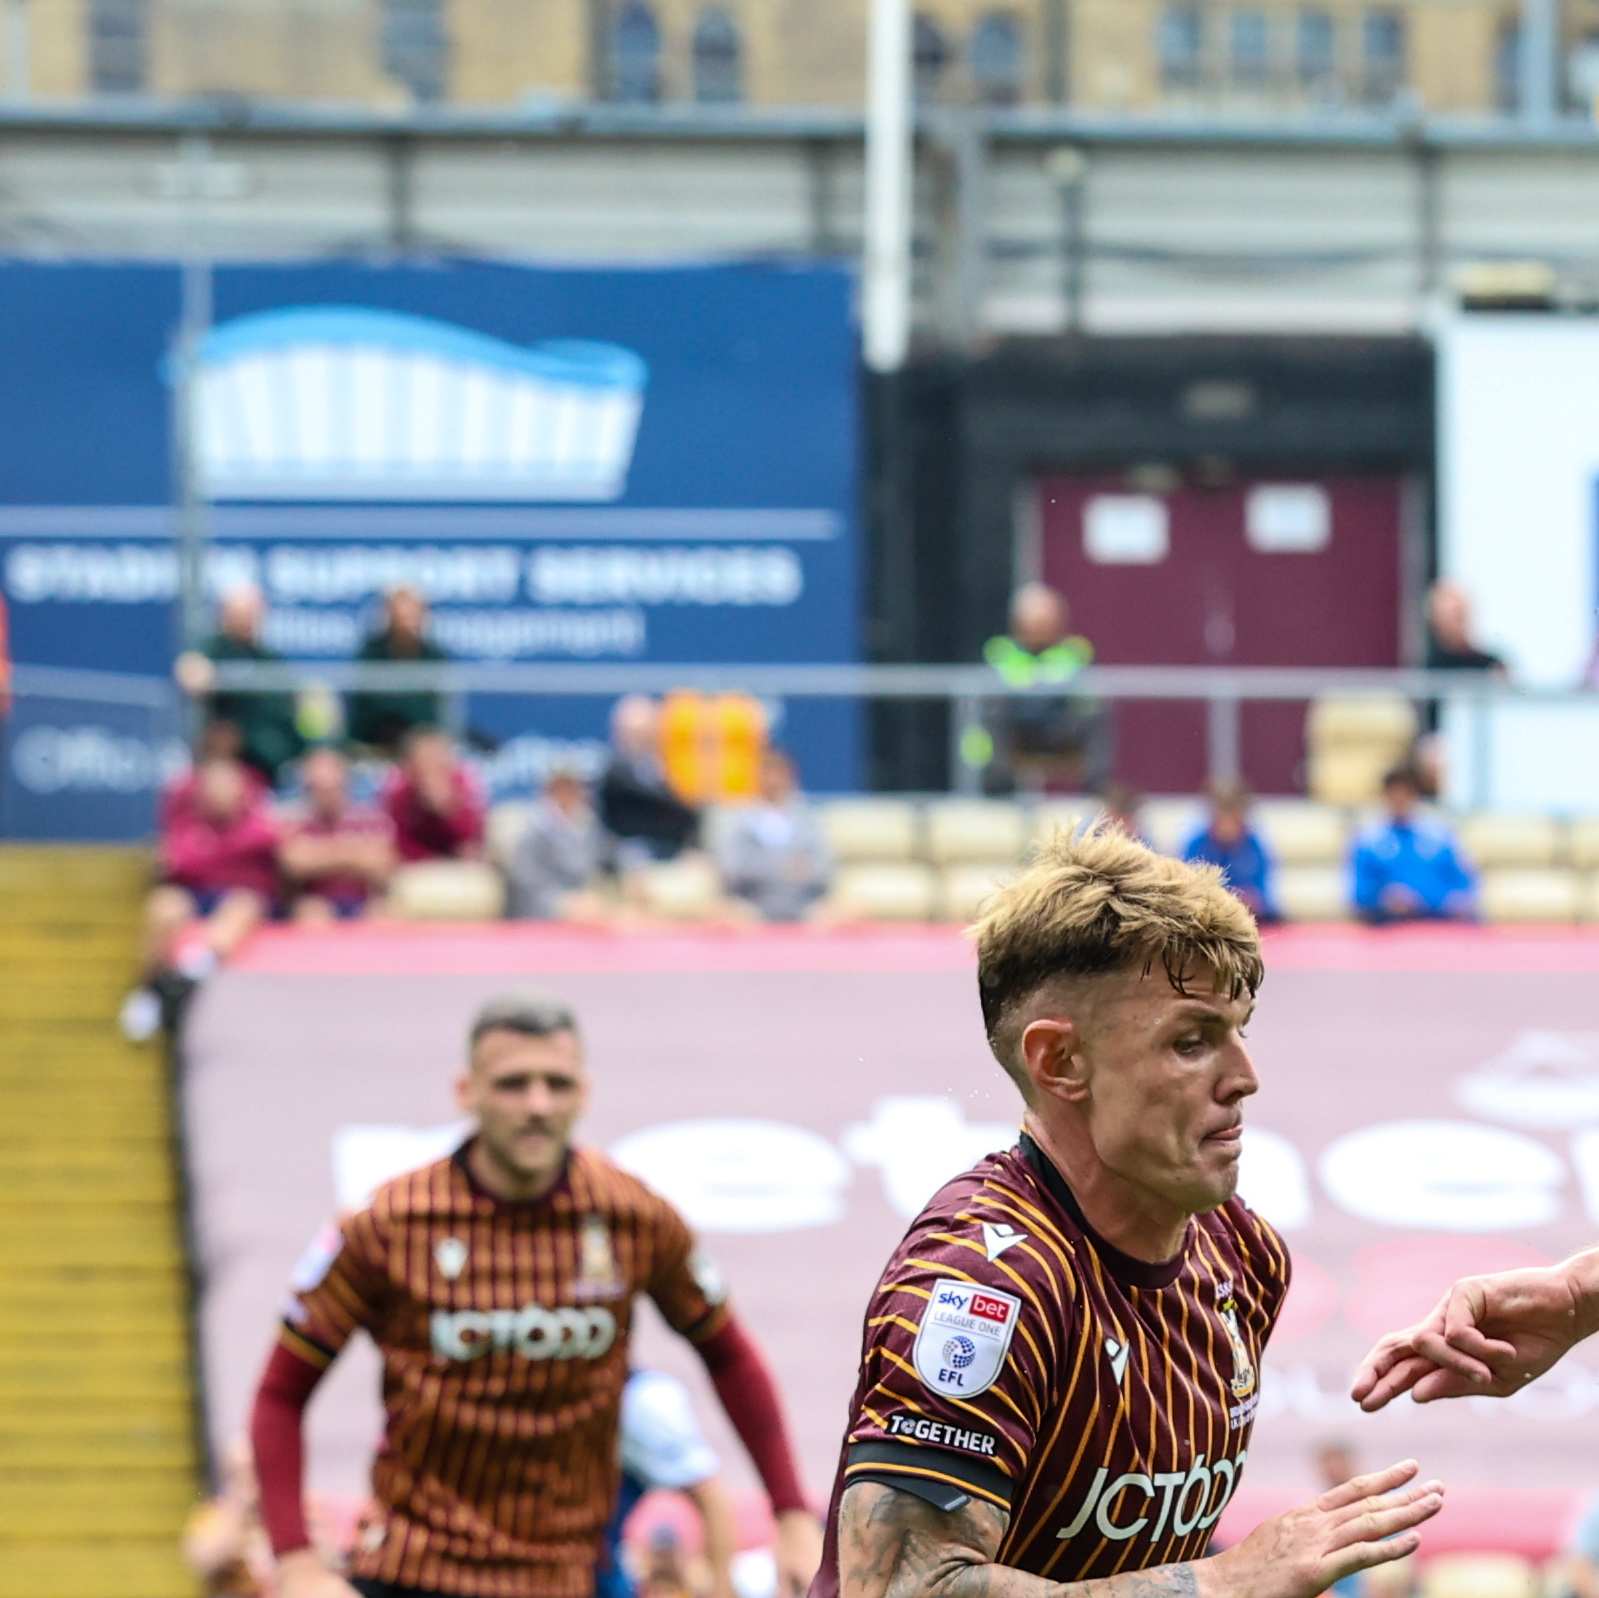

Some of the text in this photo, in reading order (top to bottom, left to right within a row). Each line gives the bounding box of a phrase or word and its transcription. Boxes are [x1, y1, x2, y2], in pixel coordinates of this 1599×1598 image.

[938, 1290, 1006, 1319] sky bet
[933, 1311, 1002, 1337] LEAGUE ONE
[938, 1368, 964, 1388] EFL
